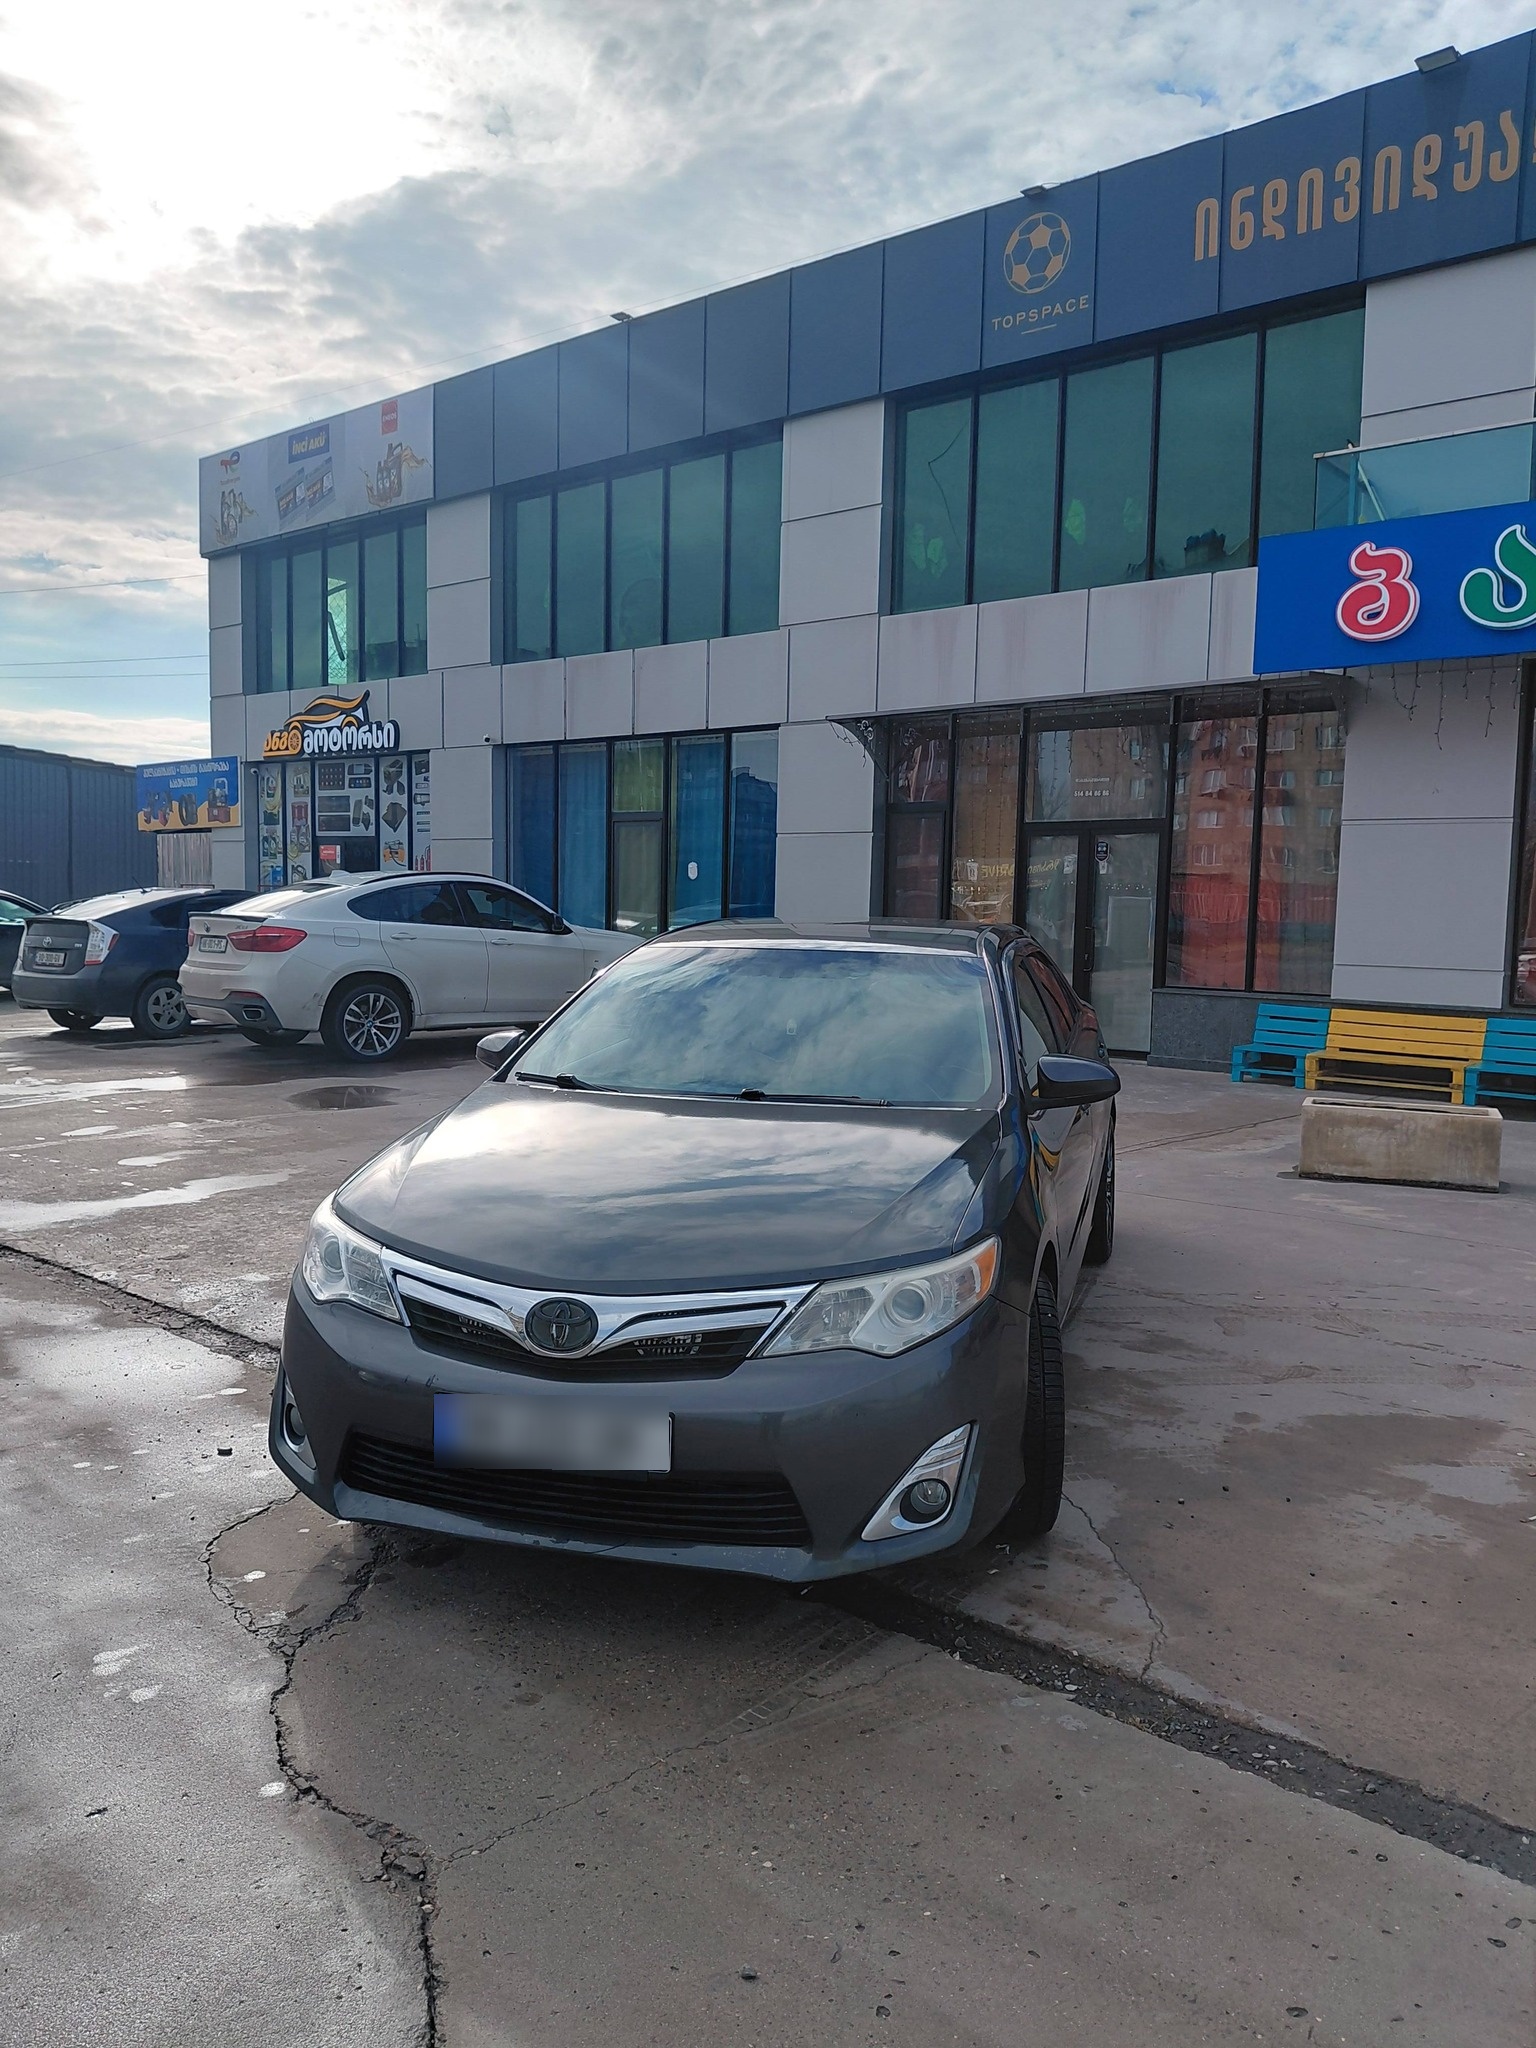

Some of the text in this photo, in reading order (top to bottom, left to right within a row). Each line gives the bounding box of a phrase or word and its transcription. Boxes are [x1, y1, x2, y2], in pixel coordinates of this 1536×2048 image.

[1194, 108, 1536, 261] ინდივიდუა
[992, 294, 1089, 331] TOPSPACE
[303, 722, 395, 754] მოტორსი
